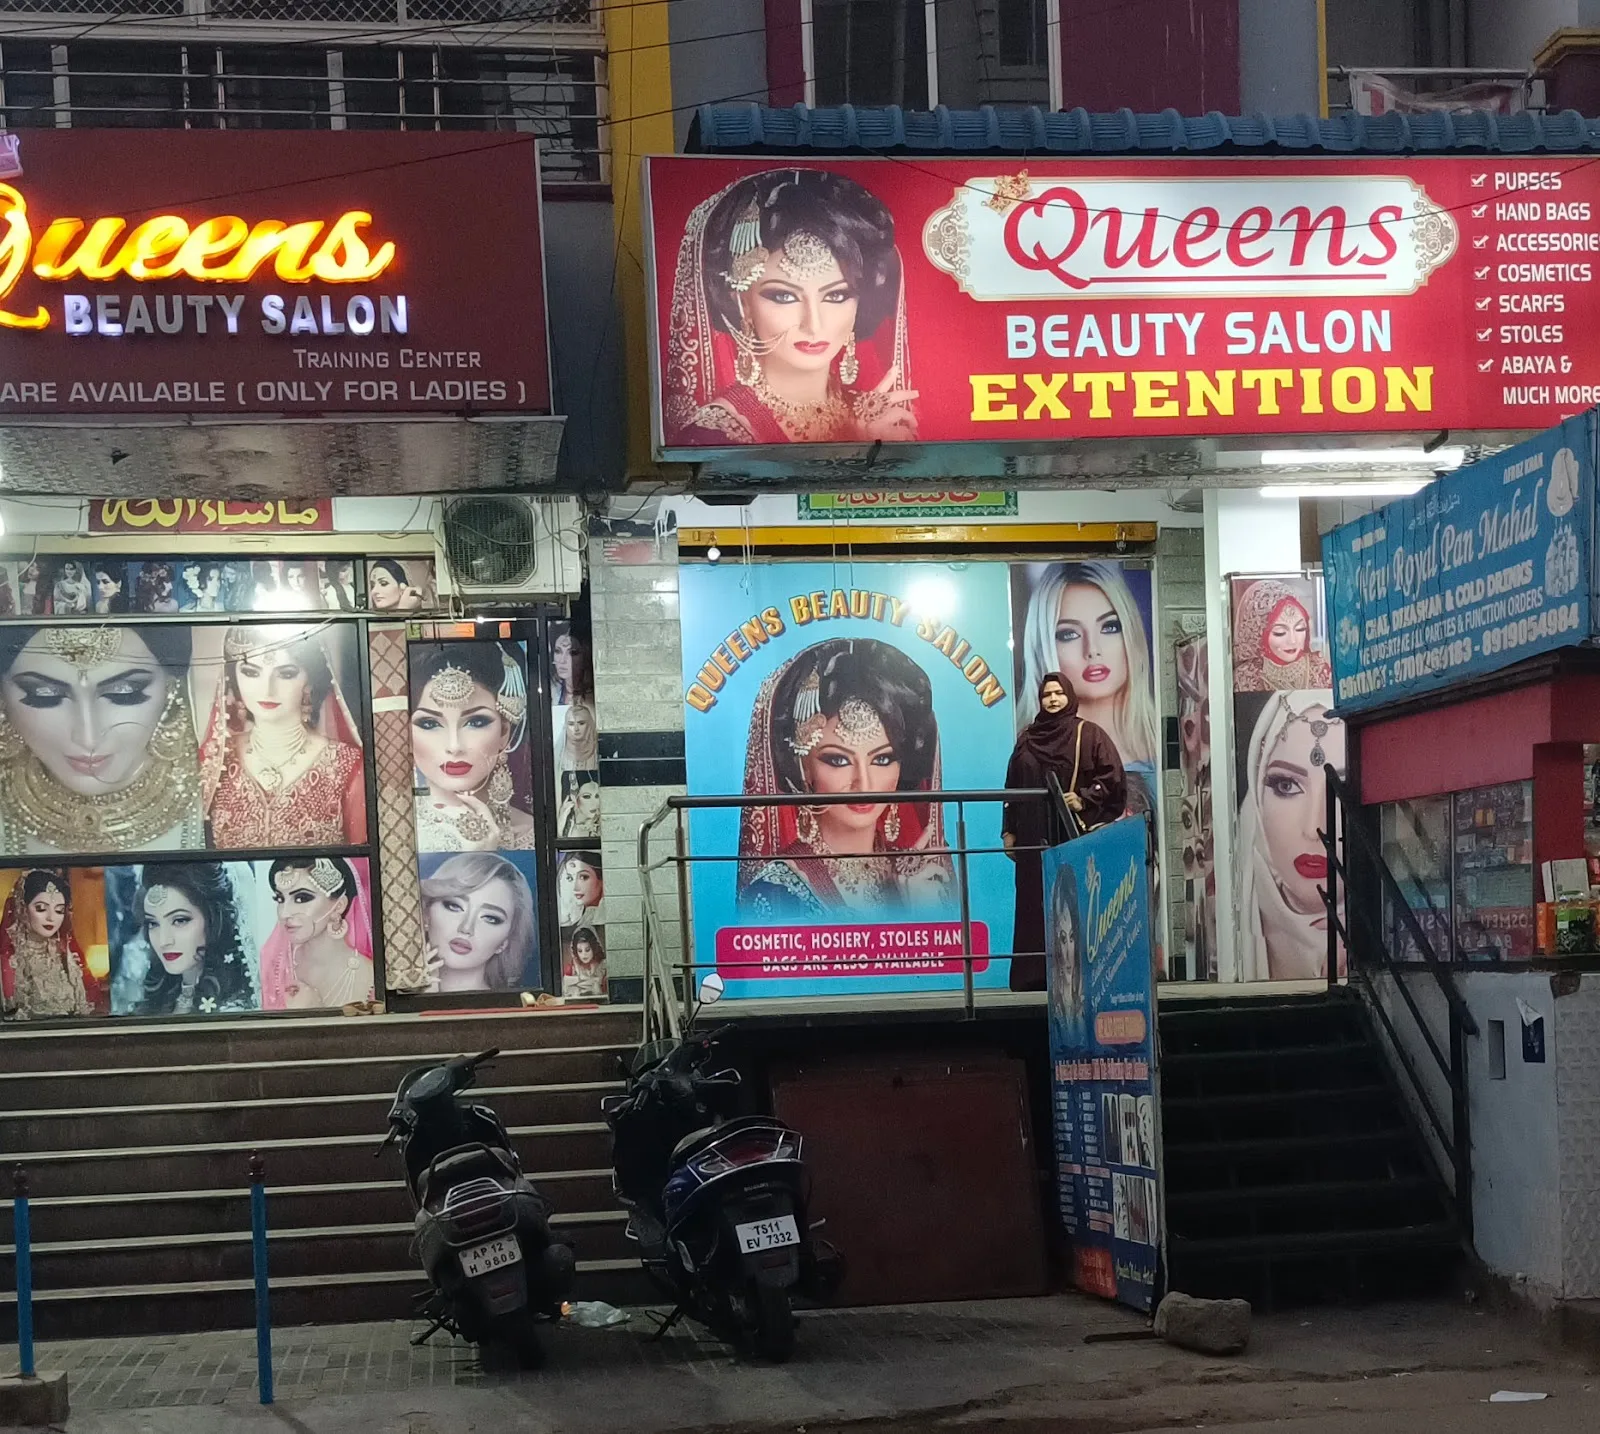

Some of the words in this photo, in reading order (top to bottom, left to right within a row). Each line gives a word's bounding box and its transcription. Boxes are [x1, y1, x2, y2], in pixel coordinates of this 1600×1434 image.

[1494, 171, 1562, 191] PURSES
[1495, 202, 1541, 221] HAND
[1545, 202, 1591, 221] BAGS
[1003, 186, 1404, 291] Queens
[1496, 232, 1600, 252] ACCESSORIE
[1497, 263, 1592, 282] COSMETICS
[1498, 294, 1565, 313] SCARFS
[63, 294, 245, 337] BEAUTY
[261, 294, 408, 336] SALON
[1006, 312, 1205, 359] BEAUTY
[1227, 309, 1392, 355] SALON
[1500, 324, 1564, 344] STOLES
[1501, 355, 1557, 374] ABAYA
[1560, 355, 1573, 374] &
[68, 381, 226, 403] AVAILABLE
[256, 380, 333, 402] ONLY
[344, 380, 399, 401] FOR
[410, 380, 507, 401] LADIES
[968, 365, 1434, 422] EXTENTION
[1503, 386, 1550, 405] MUCH
[1555, 385, 1600, 404] MORE
[1392, 521, 1441, 602] Royal
[1440, 524, 1474, 573] Pan
[1478, 477, 1544, 560] Mahal
[1455, 578, 1486, 609] COLD
[1487, 559, 1534, 598] DRINKS
[1465, 599, 1507, 632] FUNCTION
[1507, 585, 1544, 617] ORDERS
[685, 605, 787, 714] QUEENS
[788, 588, 910, 628] BEAUTY
[915, 615, 1007, 708] SALON
[732, 932, 807, 952] COSMETIC,
[811, 930, 875, 950] HOSIERY,
[879, 929, 929, 948] STOLES
[753, 1220, 781, 1236] TS11
[472, 1247, 488, 1260] AP
[490, 1241, 504, 1254] 12
[746, 1238, 760, 1250] EV
[766, 1231, 793, 1246] 7332
[469, 1264, 478, 1275] H
